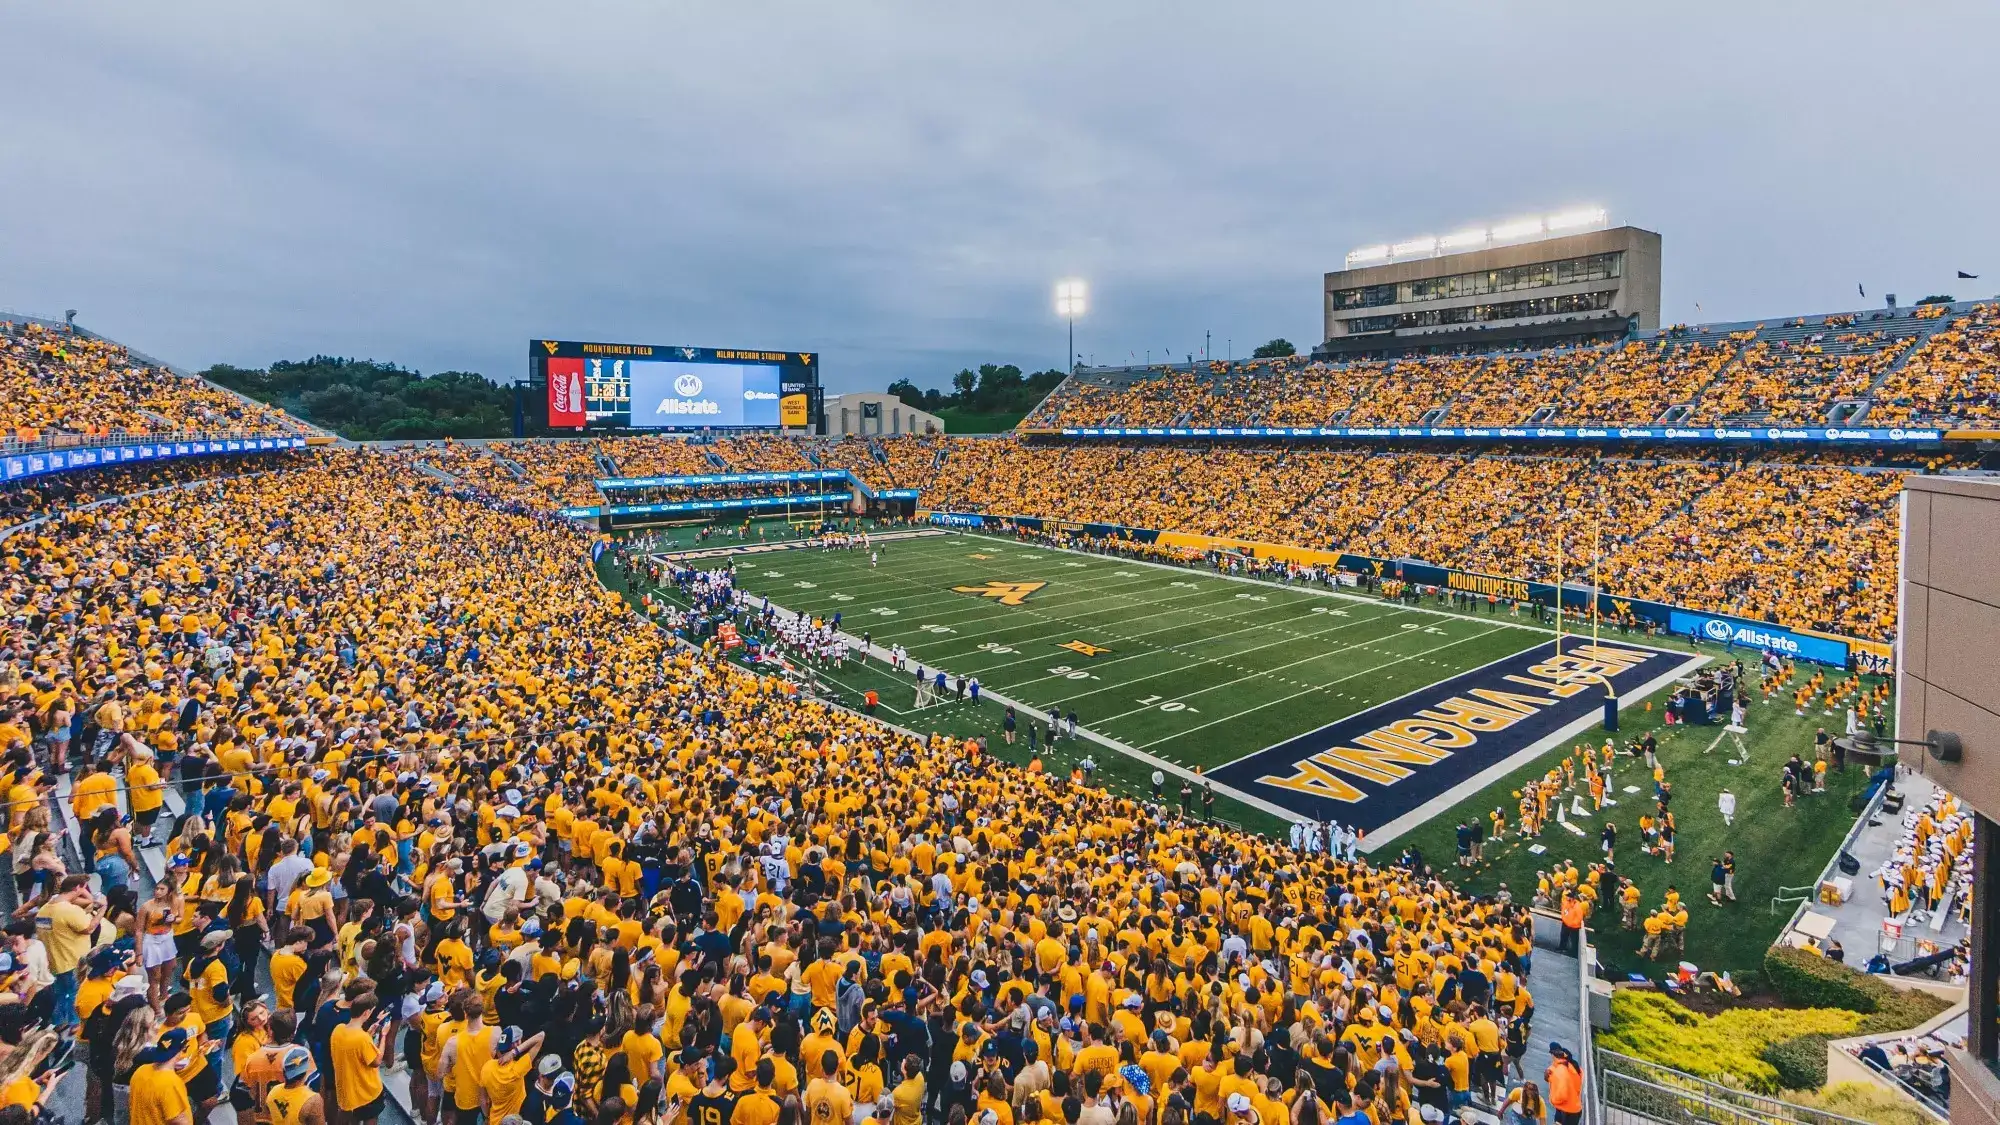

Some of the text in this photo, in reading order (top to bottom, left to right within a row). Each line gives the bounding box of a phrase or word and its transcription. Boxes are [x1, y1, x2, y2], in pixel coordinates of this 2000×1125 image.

[584, 344, 652, 356] MOUNTAINEER FIELD
[716, 350, 734, 359] MILAN
[1448, 572, 1528, 600] MOUNTAINEERS
[977, 642, 1012, 654] 30
[1047, 666, 1090, 680] 20
[1136, 694, 1186, 712] 10
[1254, 644, 1658, 803] WEST VIRGINIA
[708, 859, 716, 871] 8
[768, 862, 780, 878] 21
[1290, 890, 1297, 900] 8
[1309, 890, 1322, 900] 67
[1240, 910, 1248, 920] 12
[1398, 960, 1409, 976] 21
[699, 1106, 720, 1125] 19
